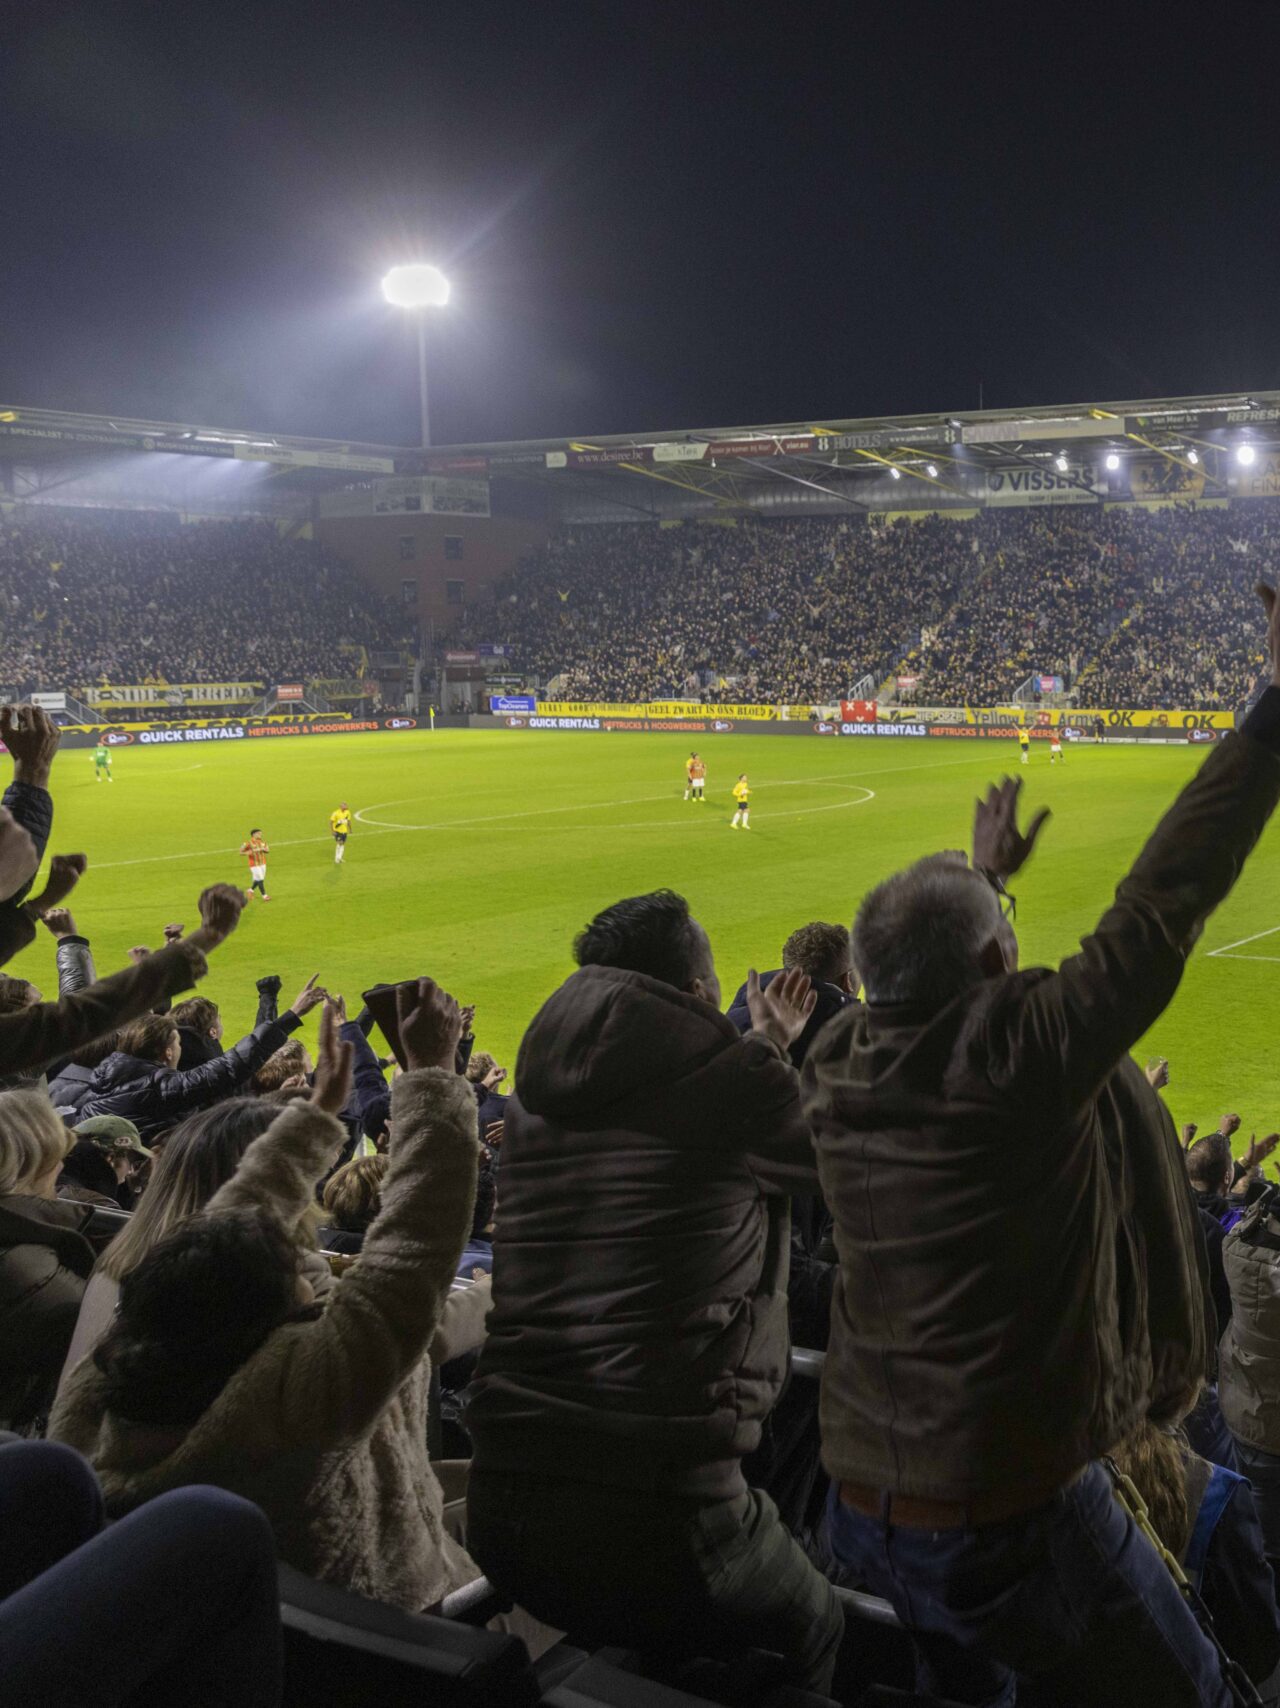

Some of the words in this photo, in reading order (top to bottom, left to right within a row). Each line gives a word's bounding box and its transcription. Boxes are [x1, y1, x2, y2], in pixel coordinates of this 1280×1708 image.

[833, 433, 882, 450] HOTELS
[1006, 467, 1096, 491] VISSERS
[648, 706, 670, 715] GEEL
[673, 705, 703, 715] ZWART
[717, 704, 734, 714] ONS
[529, 718, 558, 728] QUICK
[559, 719, 600, 729] RENTALS
[651, 721, 706, 731] HOOGWERKERS
[971, 710, 1019, 725] Yellow
[139, 731, 183, 743] QUICK
[185, 727, 244, 741] RENTALS
[248, 726, 300, 736] HEFTRUCKS
[302, 725, 309, 734] &
[311, 721, 379, 733] HOOGWERKERS
[841, 724, 876, 735] QUICK
[877, 724, 926, 736] RENTALS
[929, 727, 976, 737] HEFTRUCKS
